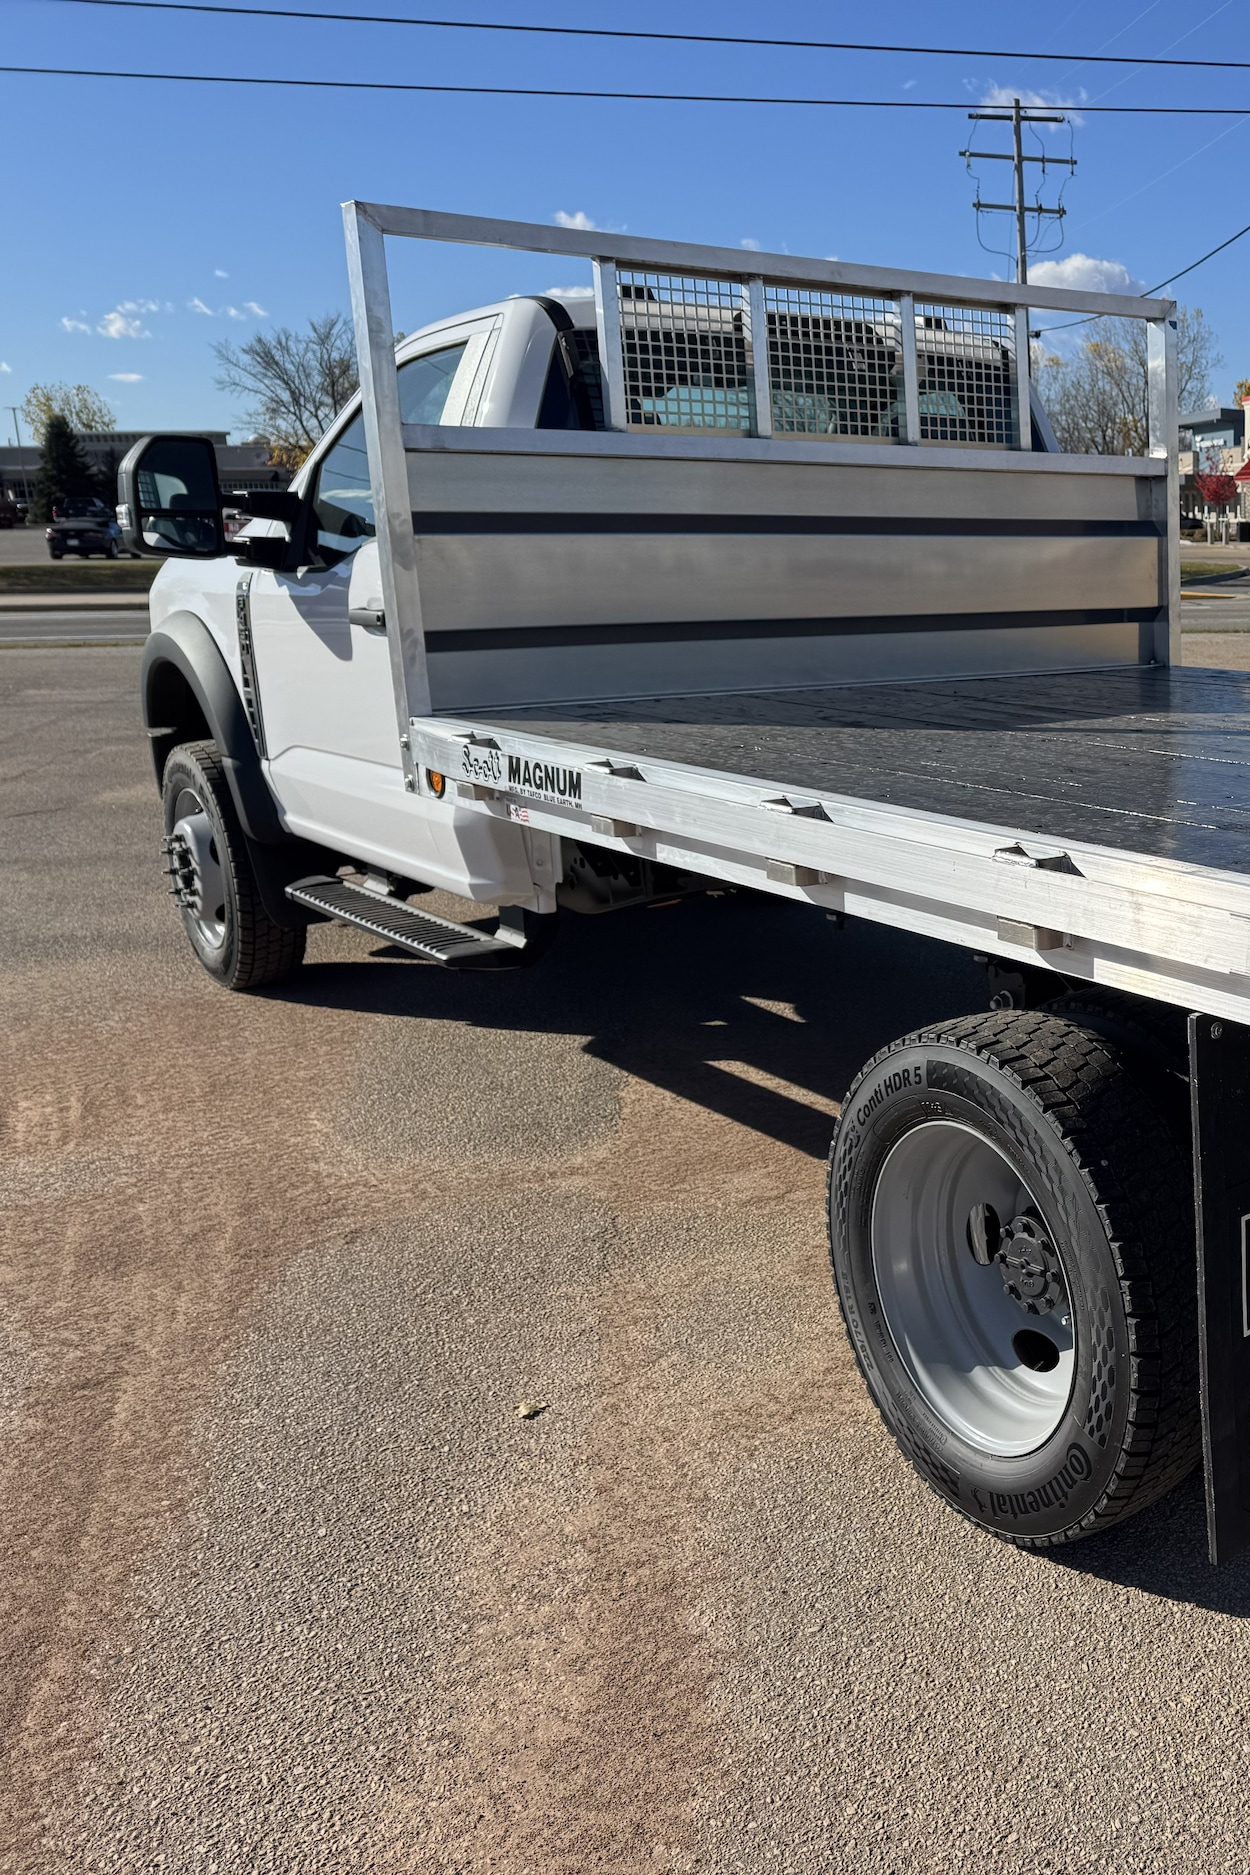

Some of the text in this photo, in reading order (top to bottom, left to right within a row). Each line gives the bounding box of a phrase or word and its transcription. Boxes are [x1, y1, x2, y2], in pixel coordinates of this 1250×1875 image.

[462, 745, 582, 800] Scott MAGNUM
[520, 788, 526, 796] BY
[543, 793, 556, 804] BLUE
[574, 800, 583, 810] MN
[857, 1066, 922, 1127] Conti HDR 5
[988, 1442, 1093, 1520] Continental
